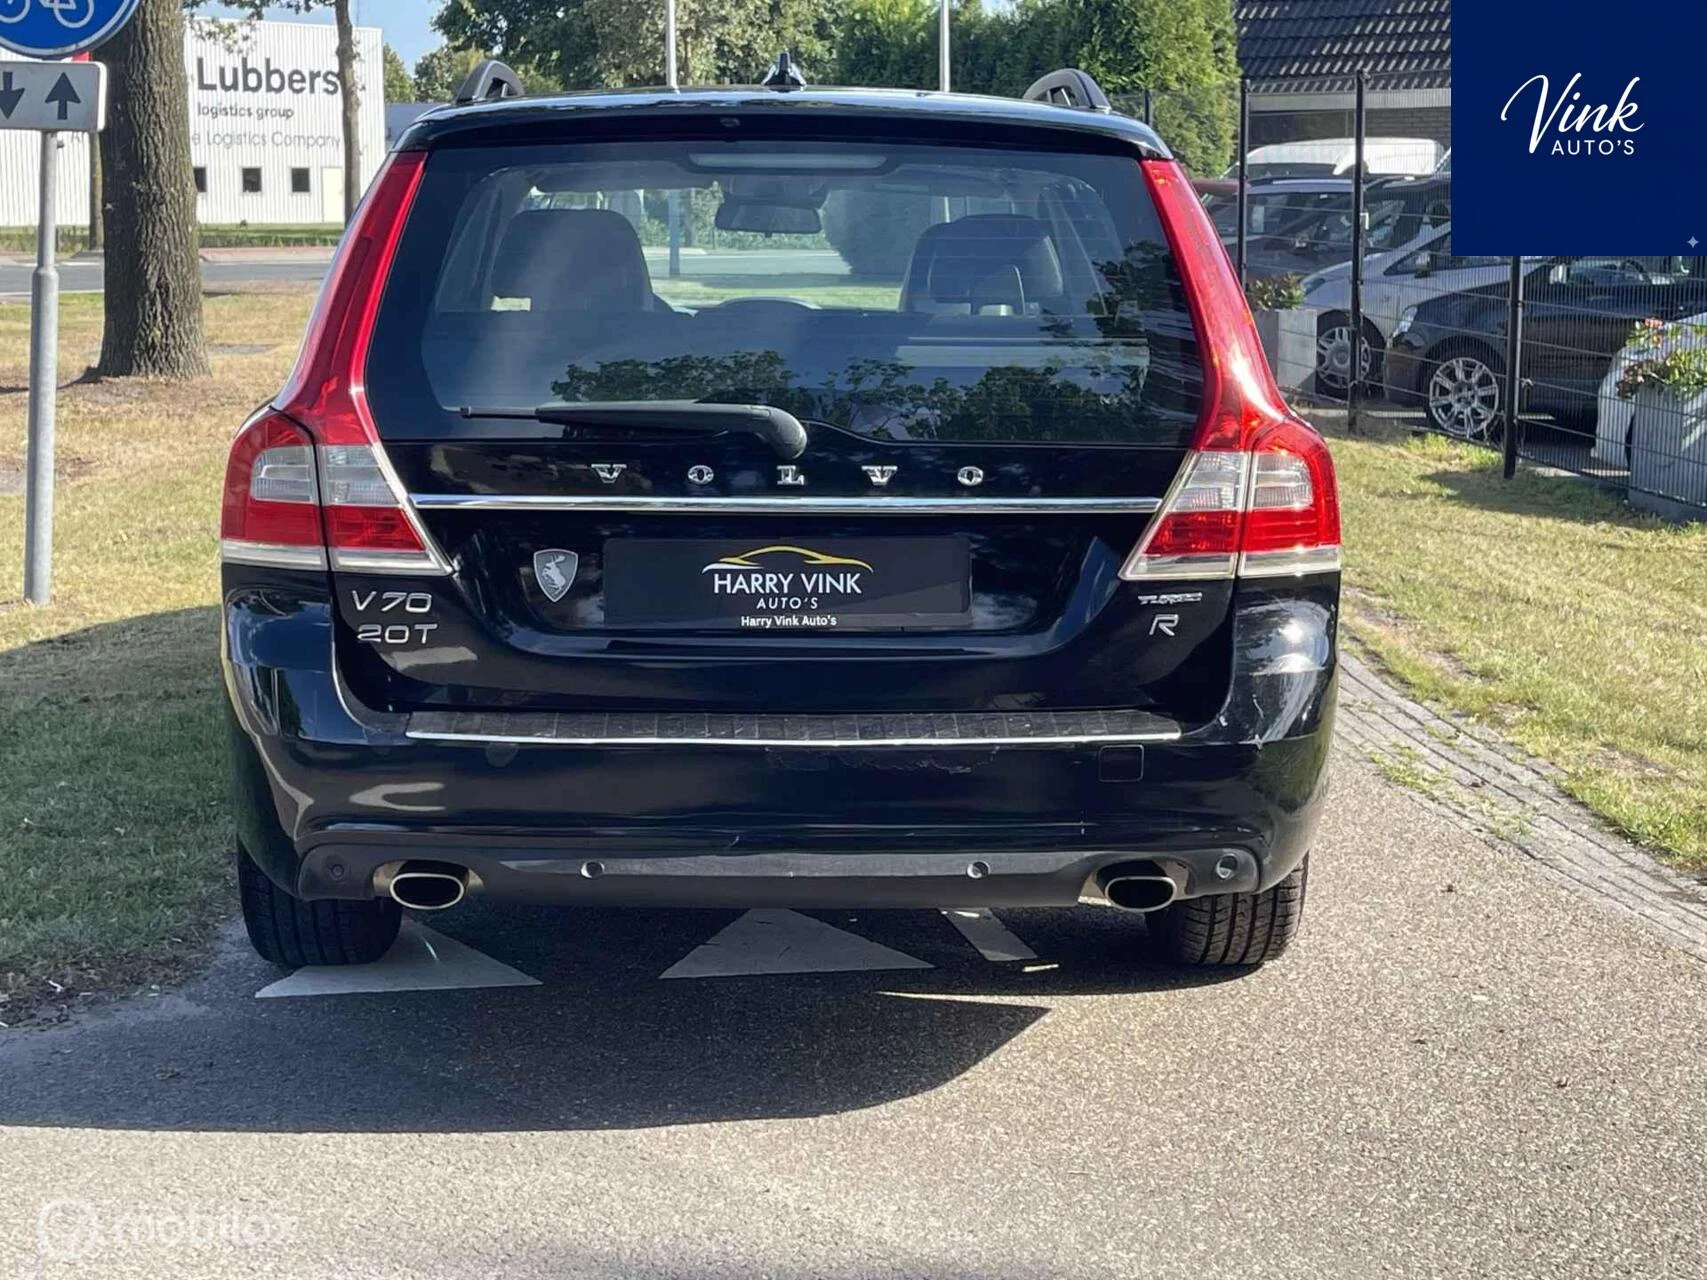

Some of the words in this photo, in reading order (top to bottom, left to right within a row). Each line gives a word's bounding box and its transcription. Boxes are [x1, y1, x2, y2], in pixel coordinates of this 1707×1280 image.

[197, 57, 339, 95] Lubbers
[198, 102, 253, 119] logistics
[256, 107, 294, 120] group
[207, 131, 267, 149] Logistics
[271, 131, 341, 149] Company
[591, 464, 984, 486] VOLVO
[714, 573, 794, 594] HARRY
[801, 573, 863, 594] VINK
[756, 597, 819, 610] AUTO'S
[741, 616, 773, 629] Harry
[775, 616, 800, 627] Vink
[801, 615, 838, 627] Auto's
[1148, 613, 1179, 636] R
